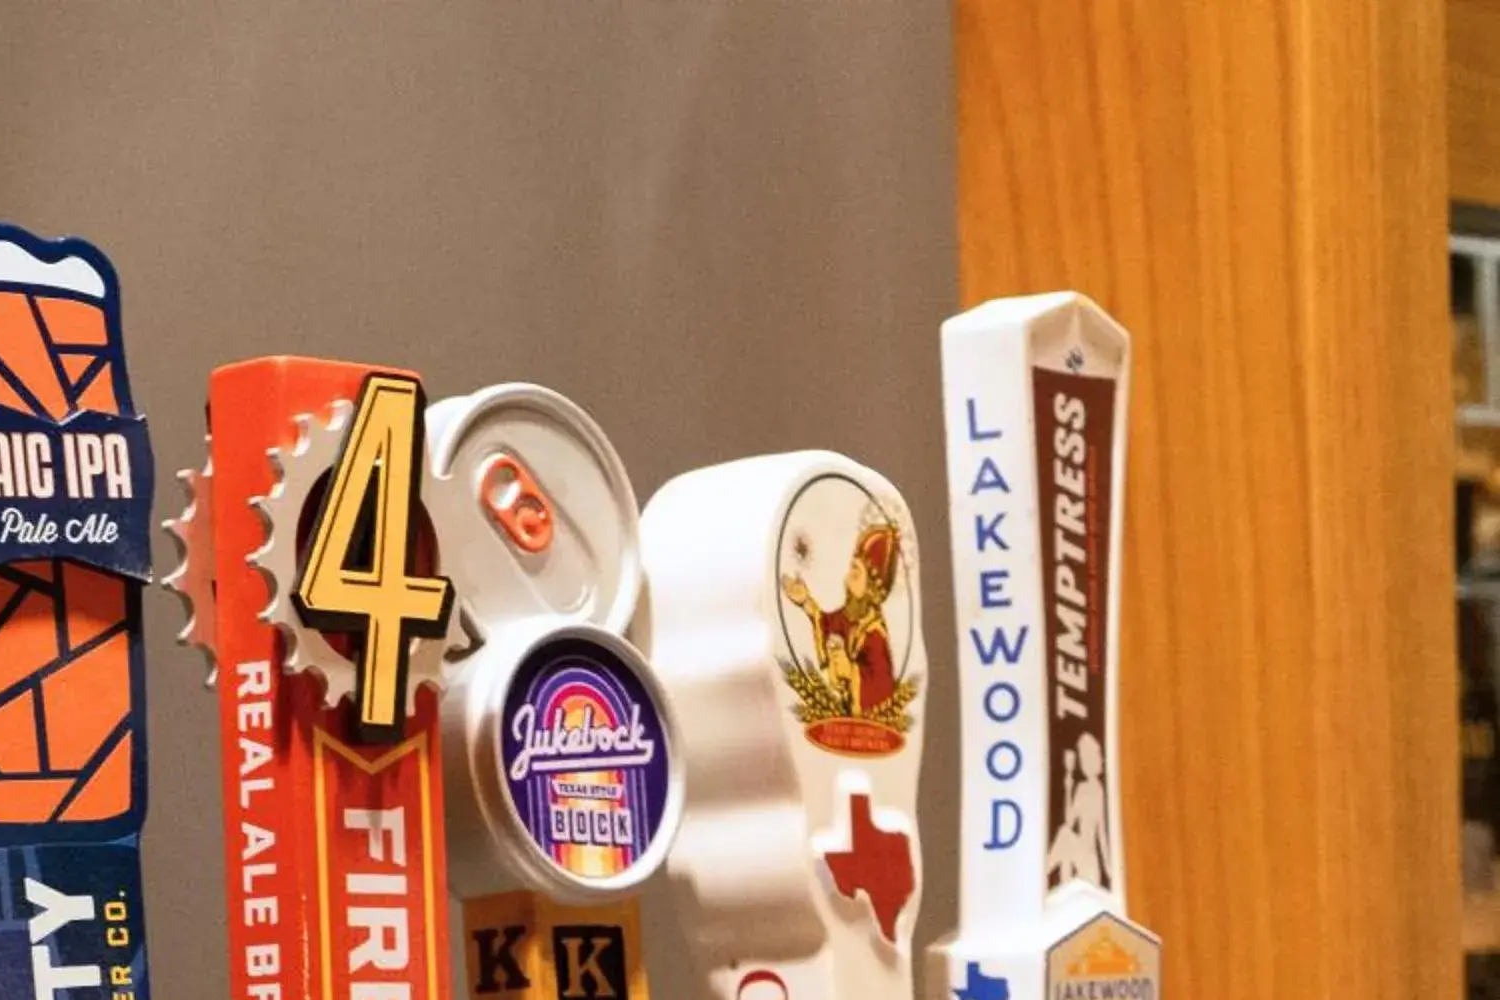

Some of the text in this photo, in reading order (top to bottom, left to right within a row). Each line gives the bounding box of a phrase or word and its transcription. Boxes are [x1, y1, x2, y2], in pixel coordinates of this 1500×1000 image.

[63, 432, 133, 498] IPA
[0, 507, 58, 544] Pale
[66, 513, 119, 544] Ale
[294, 373, 453, 734] 4
[1054, 392, 1089, 721] TEMPTRESS
[966, 397, 1029, 850] LAKEWOOD
[235, 660, 275, 811] REAL
[241, 820, 279, 928] ALE
[554, 809, 630, 838] BOCK
[104, 889, 129, 947] CO.
